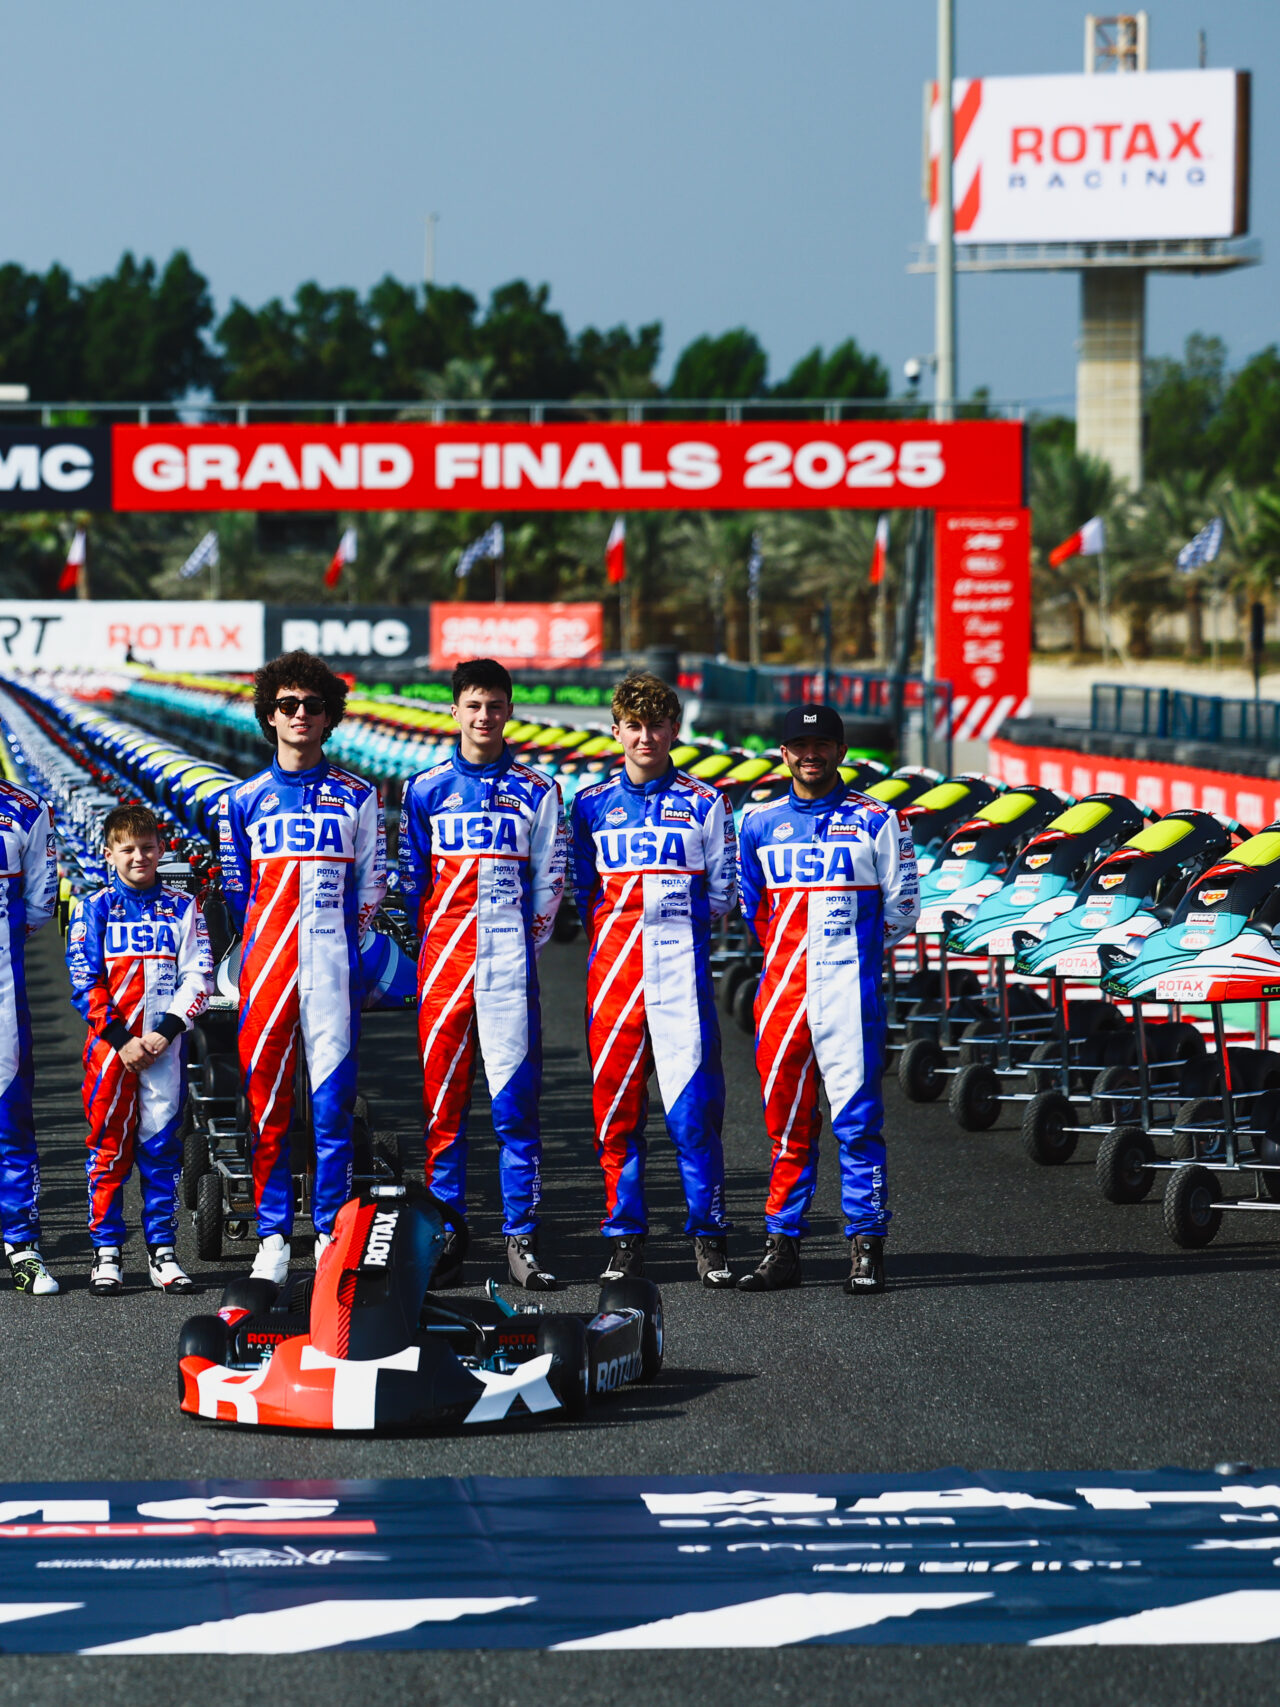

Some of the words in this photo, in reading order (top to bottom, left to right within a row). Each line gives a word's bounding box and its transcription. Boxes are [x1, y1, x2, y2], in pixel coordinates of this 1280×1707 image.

[1010, 119, 1203, 164] ROTAX
[1009, 168, 1206, 189] RACING
[133, 442, 413, 491] GRAND
[435, 442, 720, 491] FINALS
[744, 439, 945, 489] 2025
[108, 623, 242, 651] ROTAX
[282, 619, 411, 657] RMC
[320, 795, 344, 804] RMC
[665, 810, 690, 818] RMC
[258, 818, 344, 855] USA
[438, 816, 518, 852] USA
[600, 832, 687, 869] USA
[767, 847, 855, 884] USA
[317, 881, 338, 890] XPS
[826, 909, 851, 917] XPS
[106, 924, 176, 954] USA
[1058, 958, 1098, 969] ROTAX
[1158, 980, 1204, 991] ROTAX
[186, 991, 208, 1019] OTAX
[364, 1212, 399, 1266] ROTAX
[499, 1333, 537, 1345] ROTA
[596, 1350, 643, 1393] ROTAX
